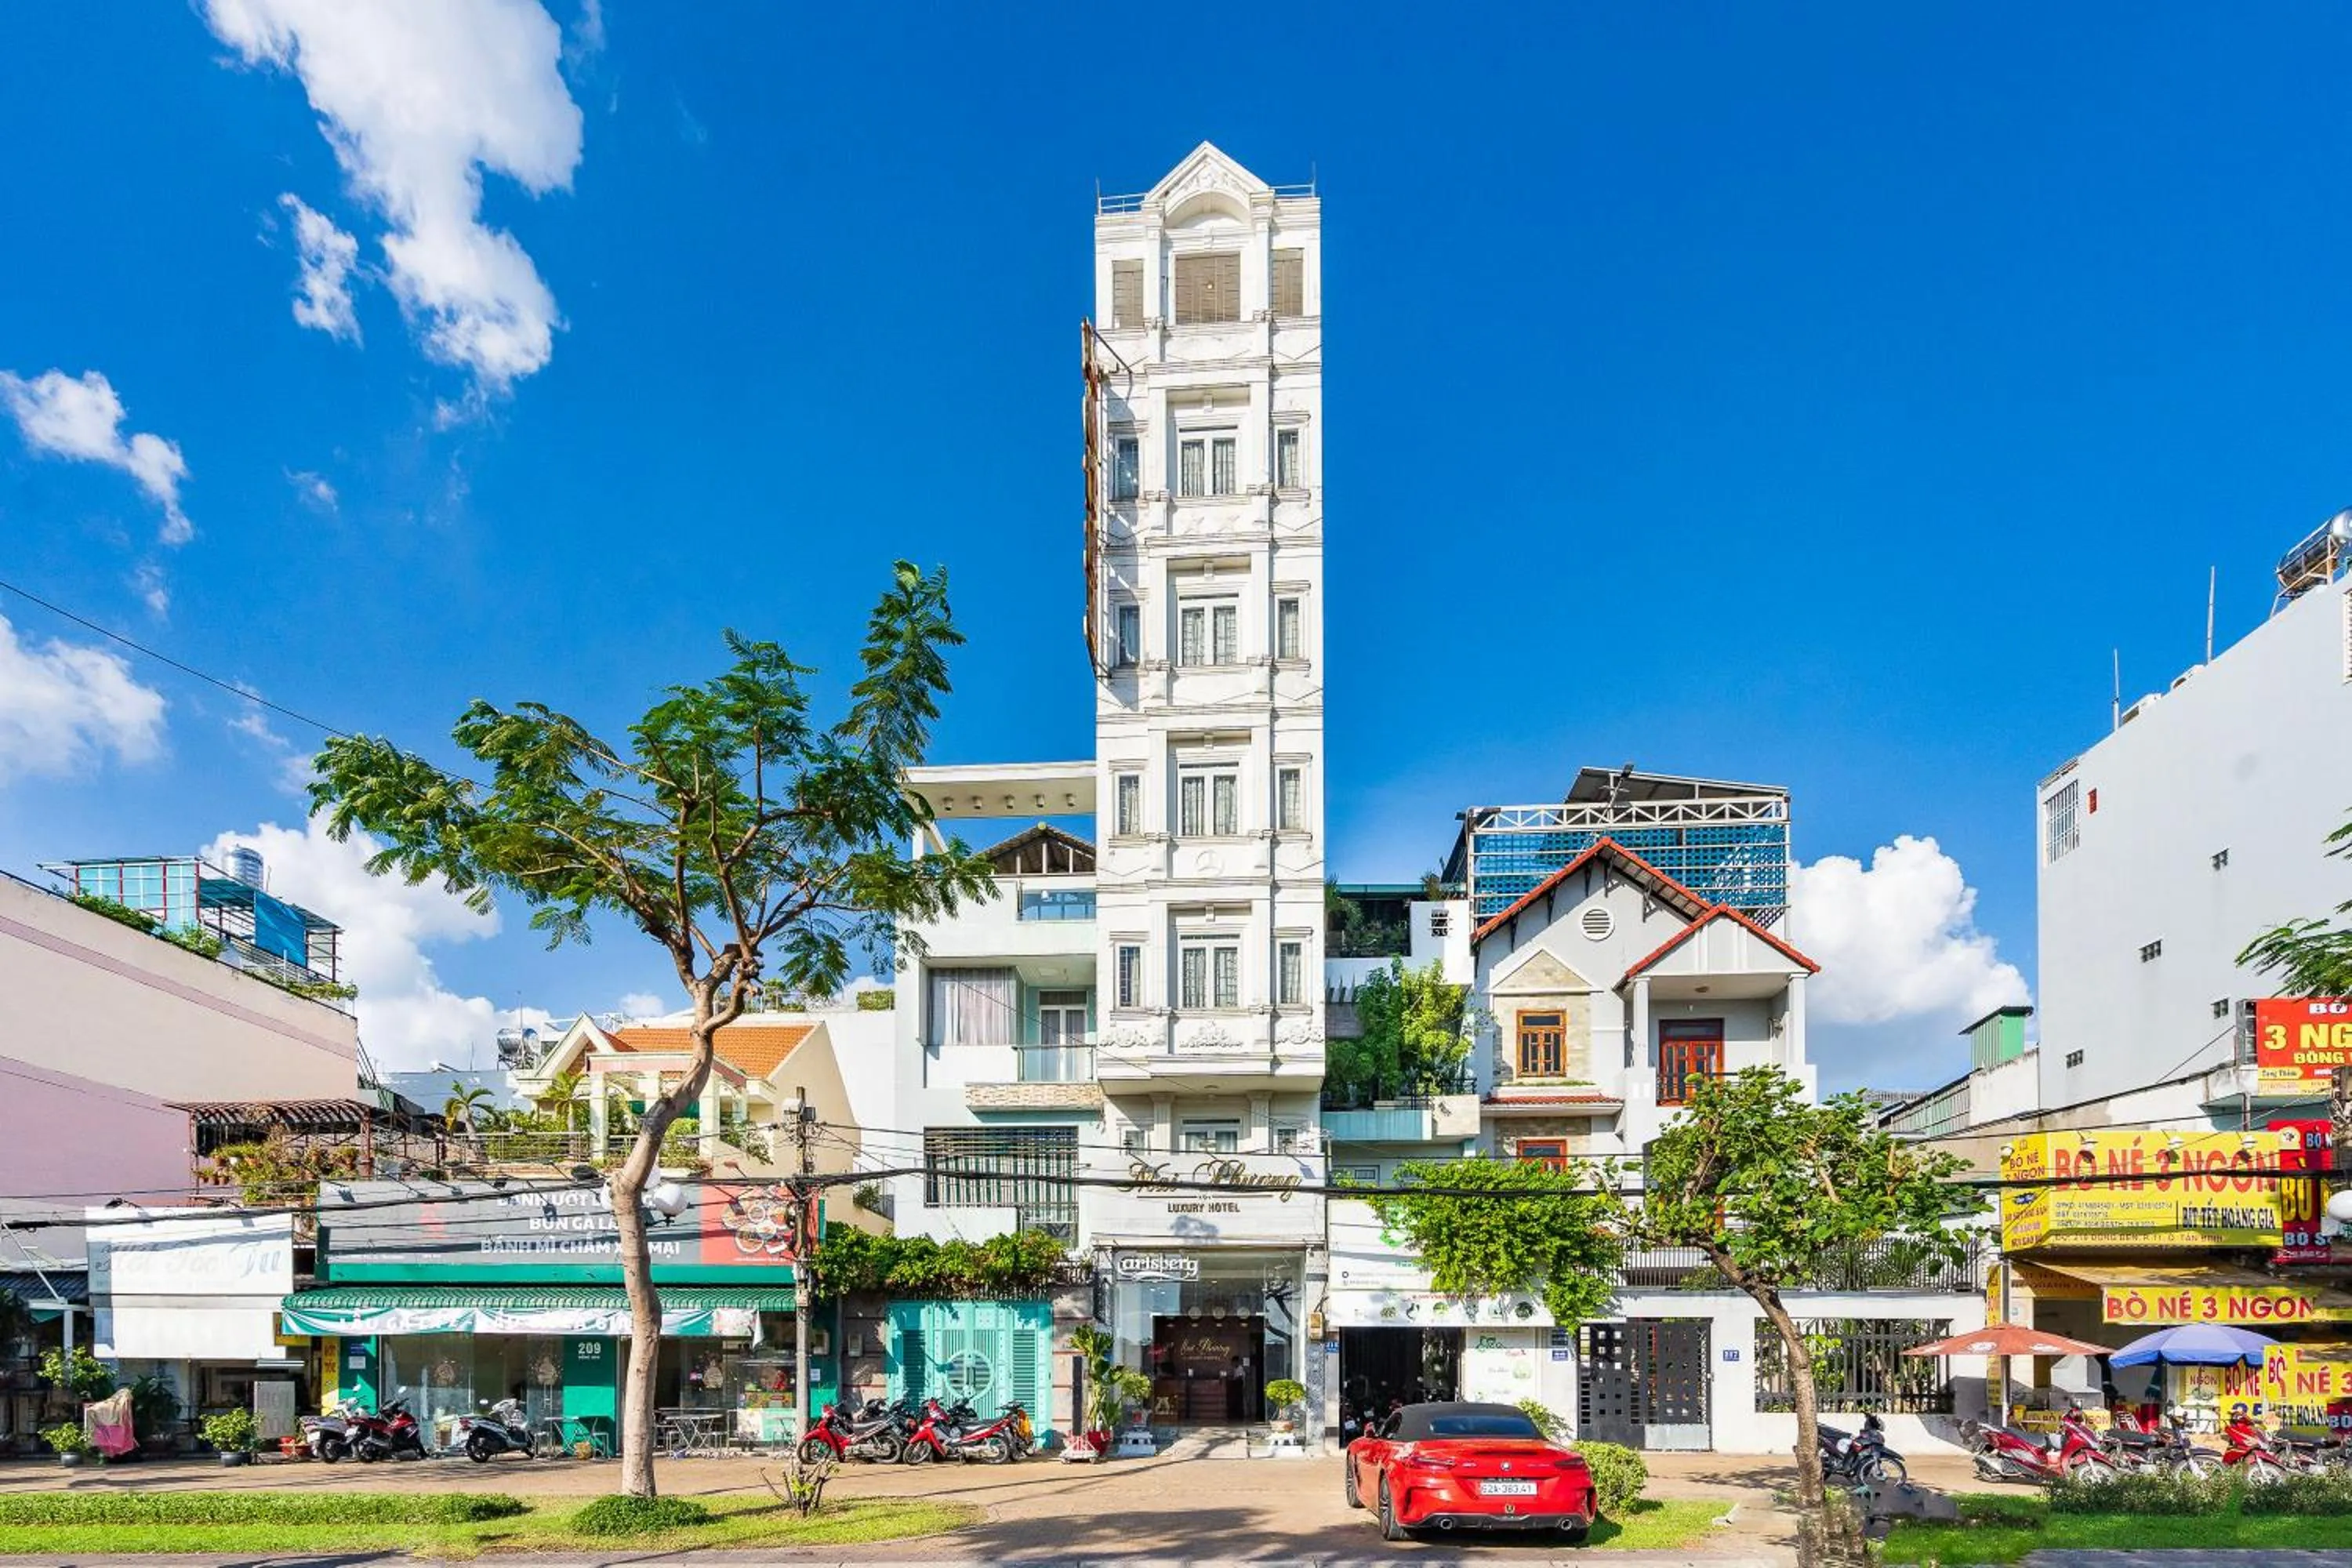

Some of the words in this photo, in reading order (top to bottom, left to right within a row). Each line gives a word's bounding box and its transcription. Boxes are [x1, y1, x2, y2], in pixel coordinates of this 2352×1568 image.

[2264, 1025, 2287, 1050] 3
[1167, 1203, 1204, 1214] LUXURY
[1208, 1202, 1241, 1213] HOTEL
[2107, 1290, 2147, 1319] BÒ
[2158, 1290, 2191, 1319] NÉ
[2202, 1295, 2218, 1319] 3
[578, 1341, 601, 1354] 209
[2296, 1365, 2331, 1393] NÉ
